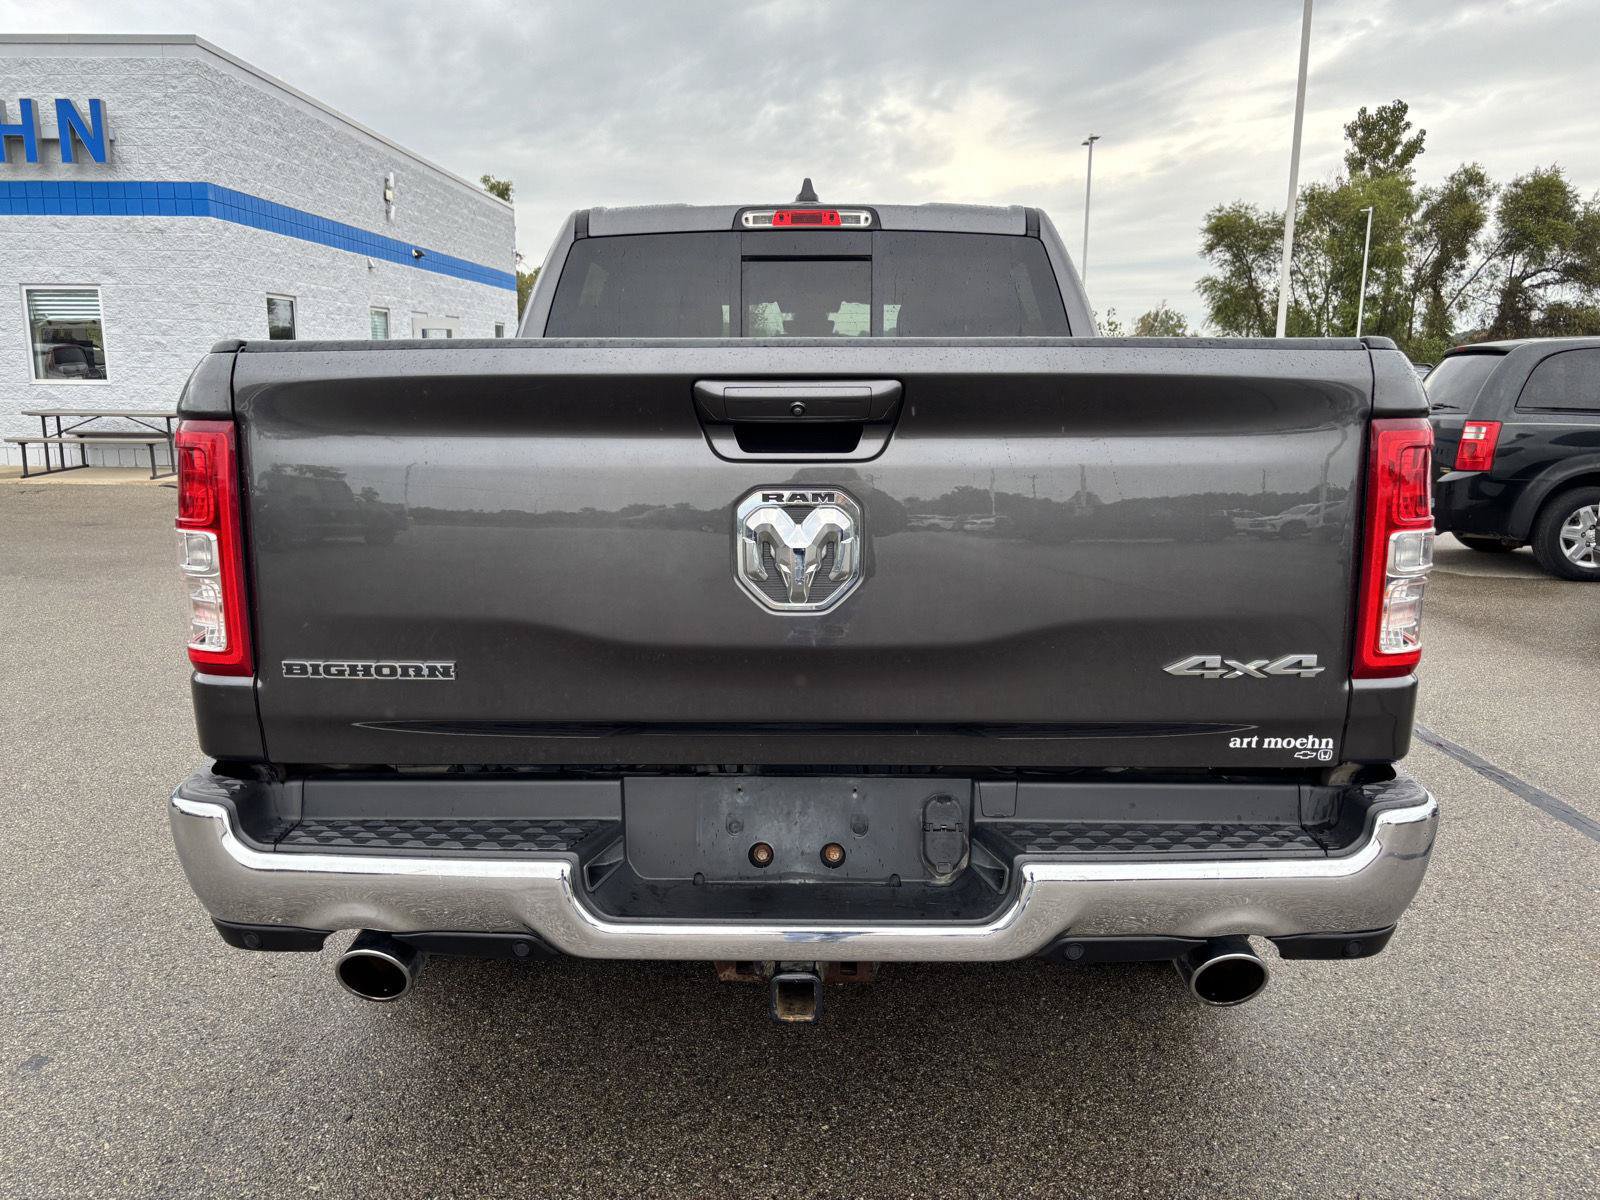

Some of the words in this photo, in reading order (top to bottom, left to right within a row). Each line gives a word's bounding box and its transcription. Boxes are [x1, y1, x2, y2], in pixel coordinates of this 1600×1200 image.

[761, 492, 835, 503] RAM
[282, 660, 457, 680] BIGHORN
[1229, 735, 1259, 749] art
[1262, 734, 1334, 749] moehn
